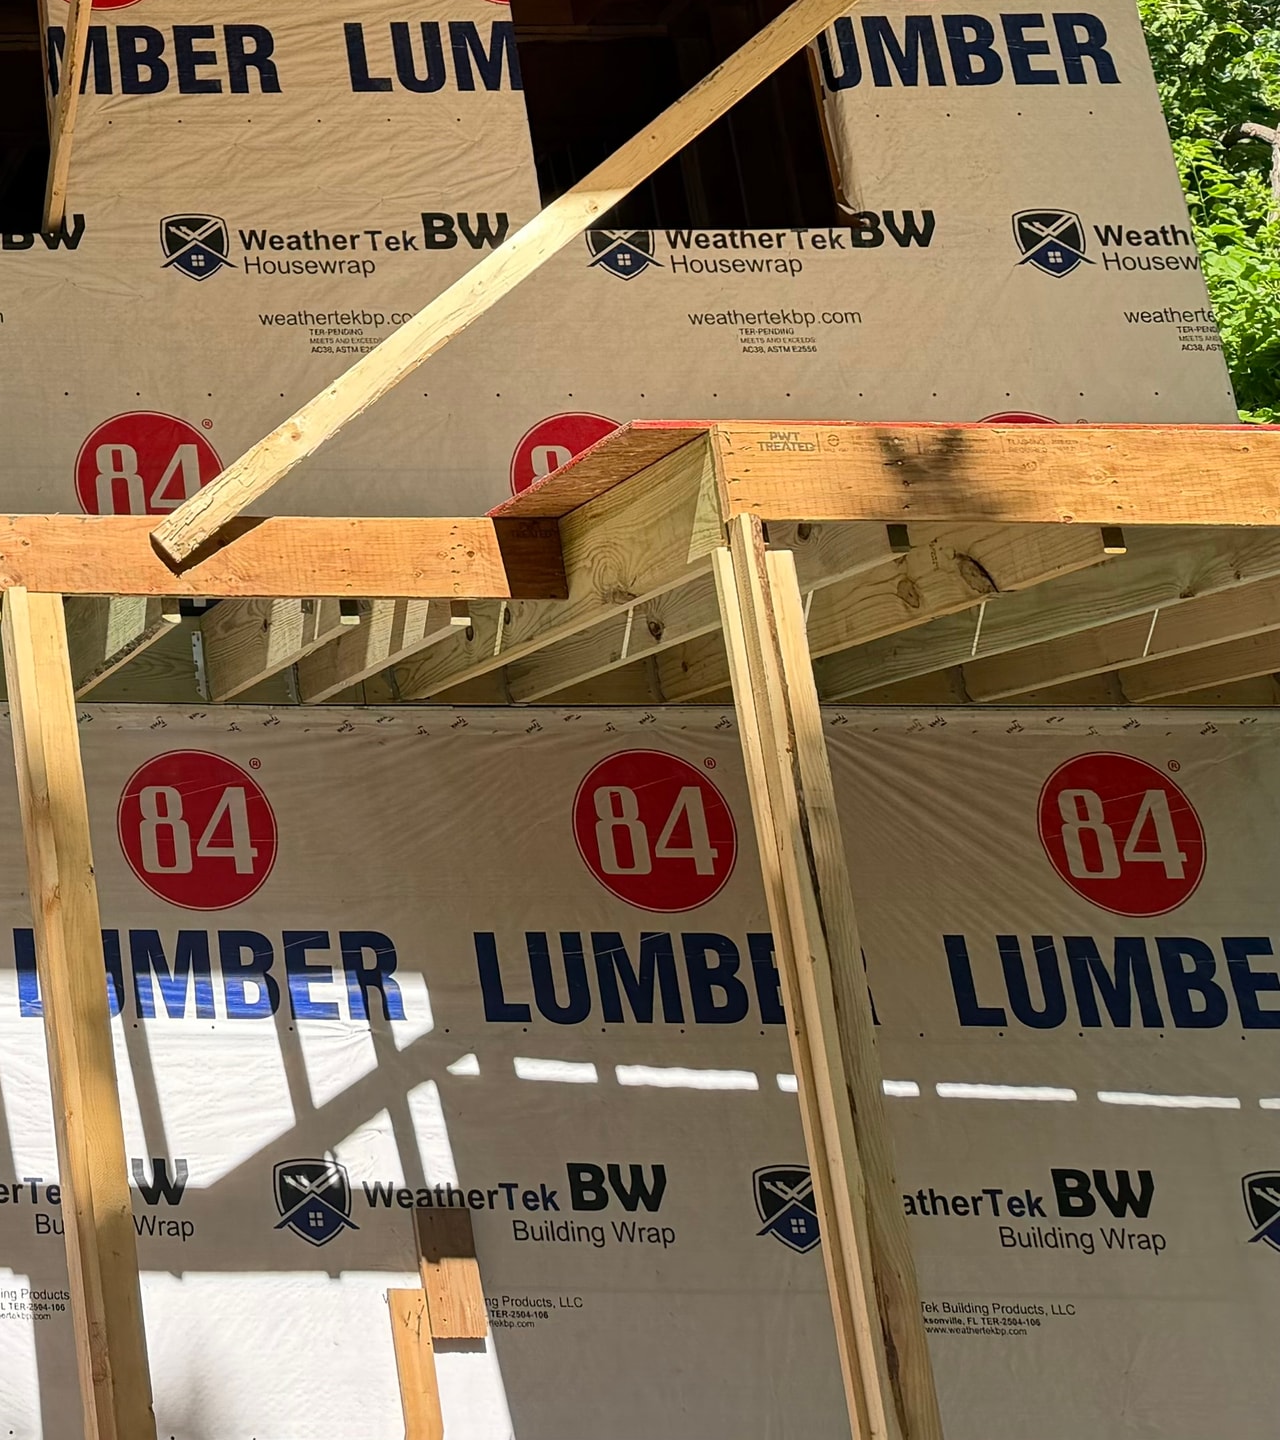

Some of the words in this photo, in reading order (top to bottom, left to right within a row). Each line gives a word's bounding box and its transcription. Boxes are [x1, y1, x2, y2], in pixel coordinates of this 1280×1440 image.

[238, 229, 361, 251] Weather
[363, 229, 419, 252] Tek
[421, 212, 510, 250] BW
[665, 229, 786, 250] Weather
[790, 227, 846, 250] Tek
[850, 209, 936, 249] BW
[244, 256, 376, 278] Housewrap
[670, 254, 803, 277] Housewrap
[687, 308, 863, 328] weathertekbp.com
[308, 328, 363, 336] TER-PENDING
[738, 327, 795, 336] TER-PENDING
[335, 345, 359, 354] ASTM
[767, 345, 791, 354] ASTM
[791, 345, 818, 354] E2556
[756, 442, 816, 452] TREATED
[769, 431, 800, 442] PWT
[140, 784, 257, 874] 84
[595, 785, 719, 876] 84
[1058, 788, 1187, 880] 84
[362, 1179, 561, 1212] WeatherTek
[566, 1162, 667, 1213] BW
[1050, 1168, 1155, 1219] BW
[132, 1214, 195, 1241] Wrap
[512, 1219, 606, 1248] Building
[611, 1220, 676, 1249] Wrap
[998, 1225, 1095, 1255] Building
[1100, 1227, 1167, 1256] Wrap
[501, 1295, 557, 1310] Products,
[559, 1296, 583, 1309] LLC
[942, 1302, 990, 1316] Building
[992, 1303, 1049, 1317] Products,
[1051, 1304, 1076, 1316] LLC
[967, 1317, 979, 1327] FL
